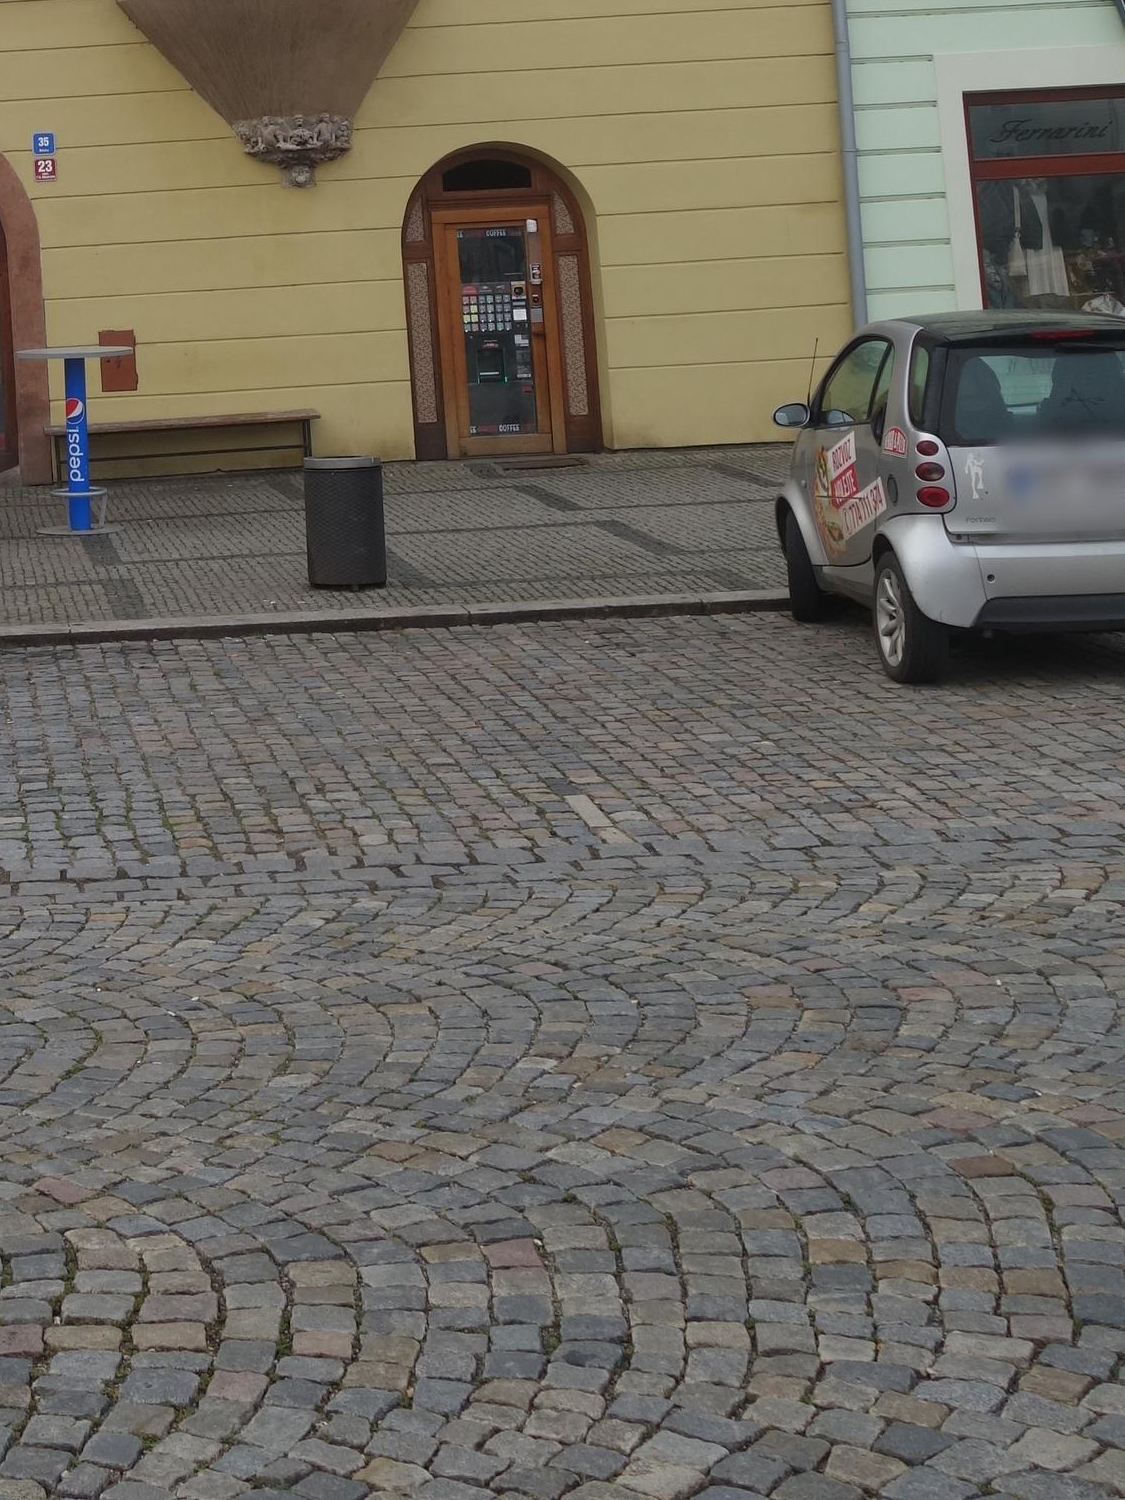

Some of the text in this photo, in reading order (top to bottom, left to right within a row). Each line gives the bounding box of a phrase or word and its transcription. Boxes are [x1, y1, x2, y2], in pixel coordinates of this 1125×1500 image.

[989, 118, 1113, 143] Ferrarini
[38, 137, 49, 147] 35
[37, 160, 53, 173] 23
[486, 229, 507, 237] COFFEE
[499, 424, 520, 432] COFFEE
[67, 428, 84, 482] pepsi
